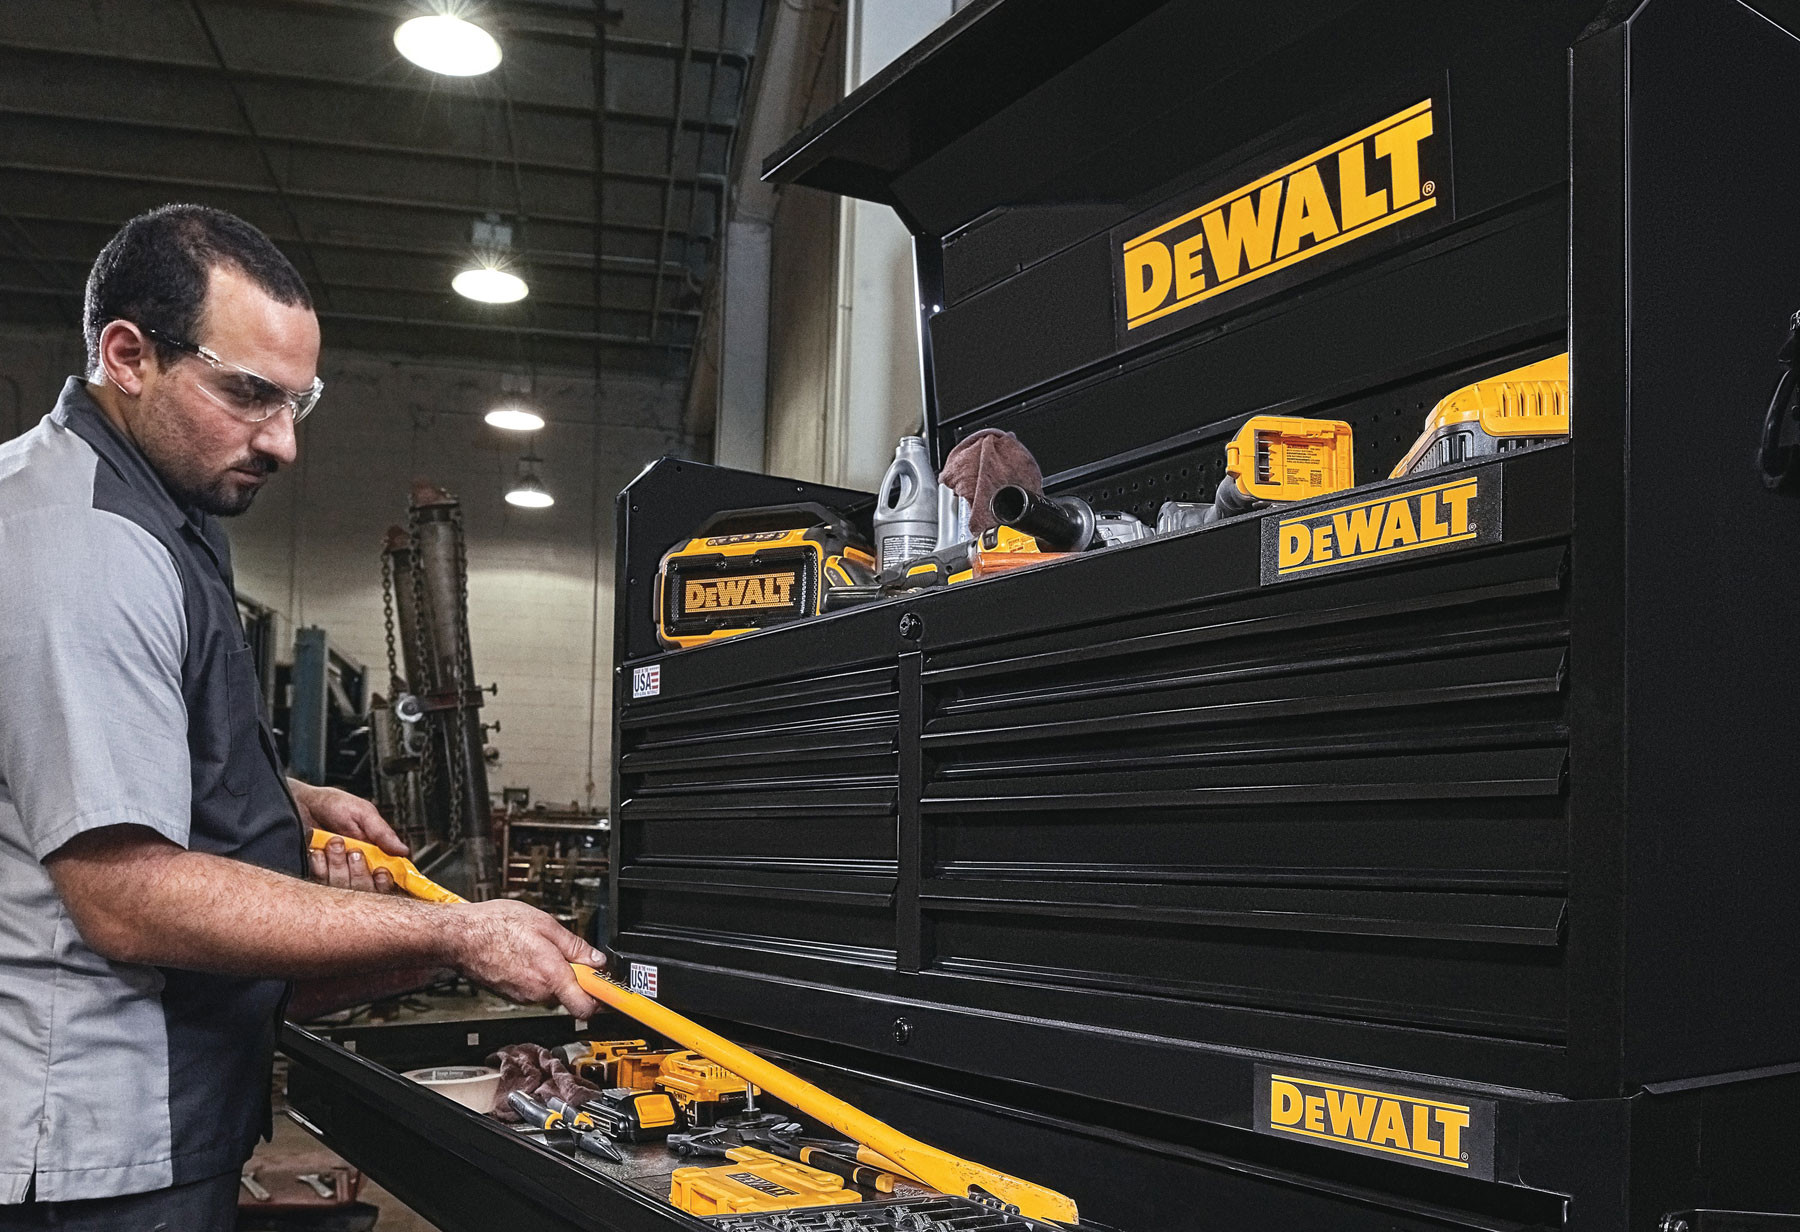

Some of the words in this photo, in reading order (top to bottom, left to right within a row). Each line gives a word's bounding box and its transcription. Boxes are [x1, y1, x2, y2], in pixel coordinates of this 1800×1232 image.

[1124, 111, 1433, 320] DEWALT
[1279, 484, 1477, 569] DEWALT
[685, 576, 795, 608] DEWALT
[635, 672, 651, 692] USA
[631, 970, 648, 990] USA
[1271, 1080, 1469, 1159] DEWALT
